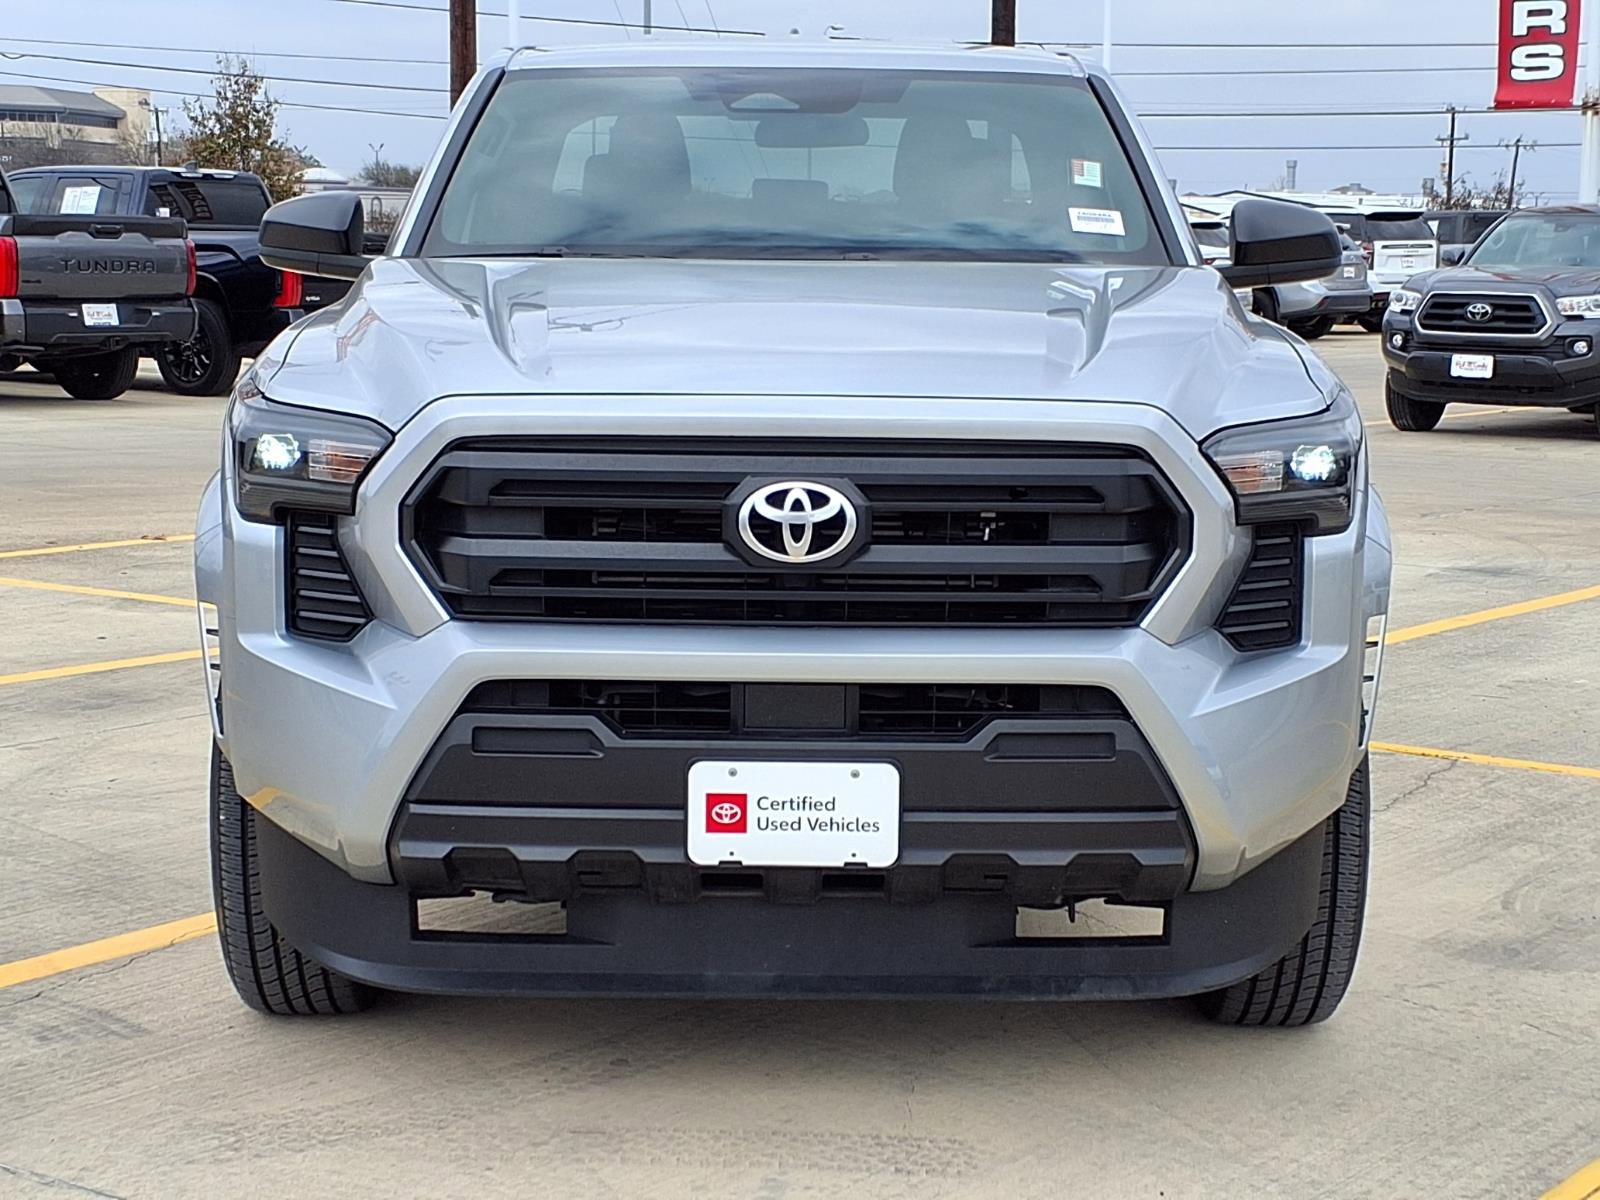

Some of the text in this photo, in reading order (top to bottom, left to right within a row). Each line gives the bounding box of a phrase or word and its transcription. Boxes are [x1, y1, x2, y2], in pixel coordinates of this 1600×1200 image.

[60, 258, 157, 274] TUNDRA
[756, 795, 836, 812] Certified
[756, 816, 880, 833] Used Vehicles
